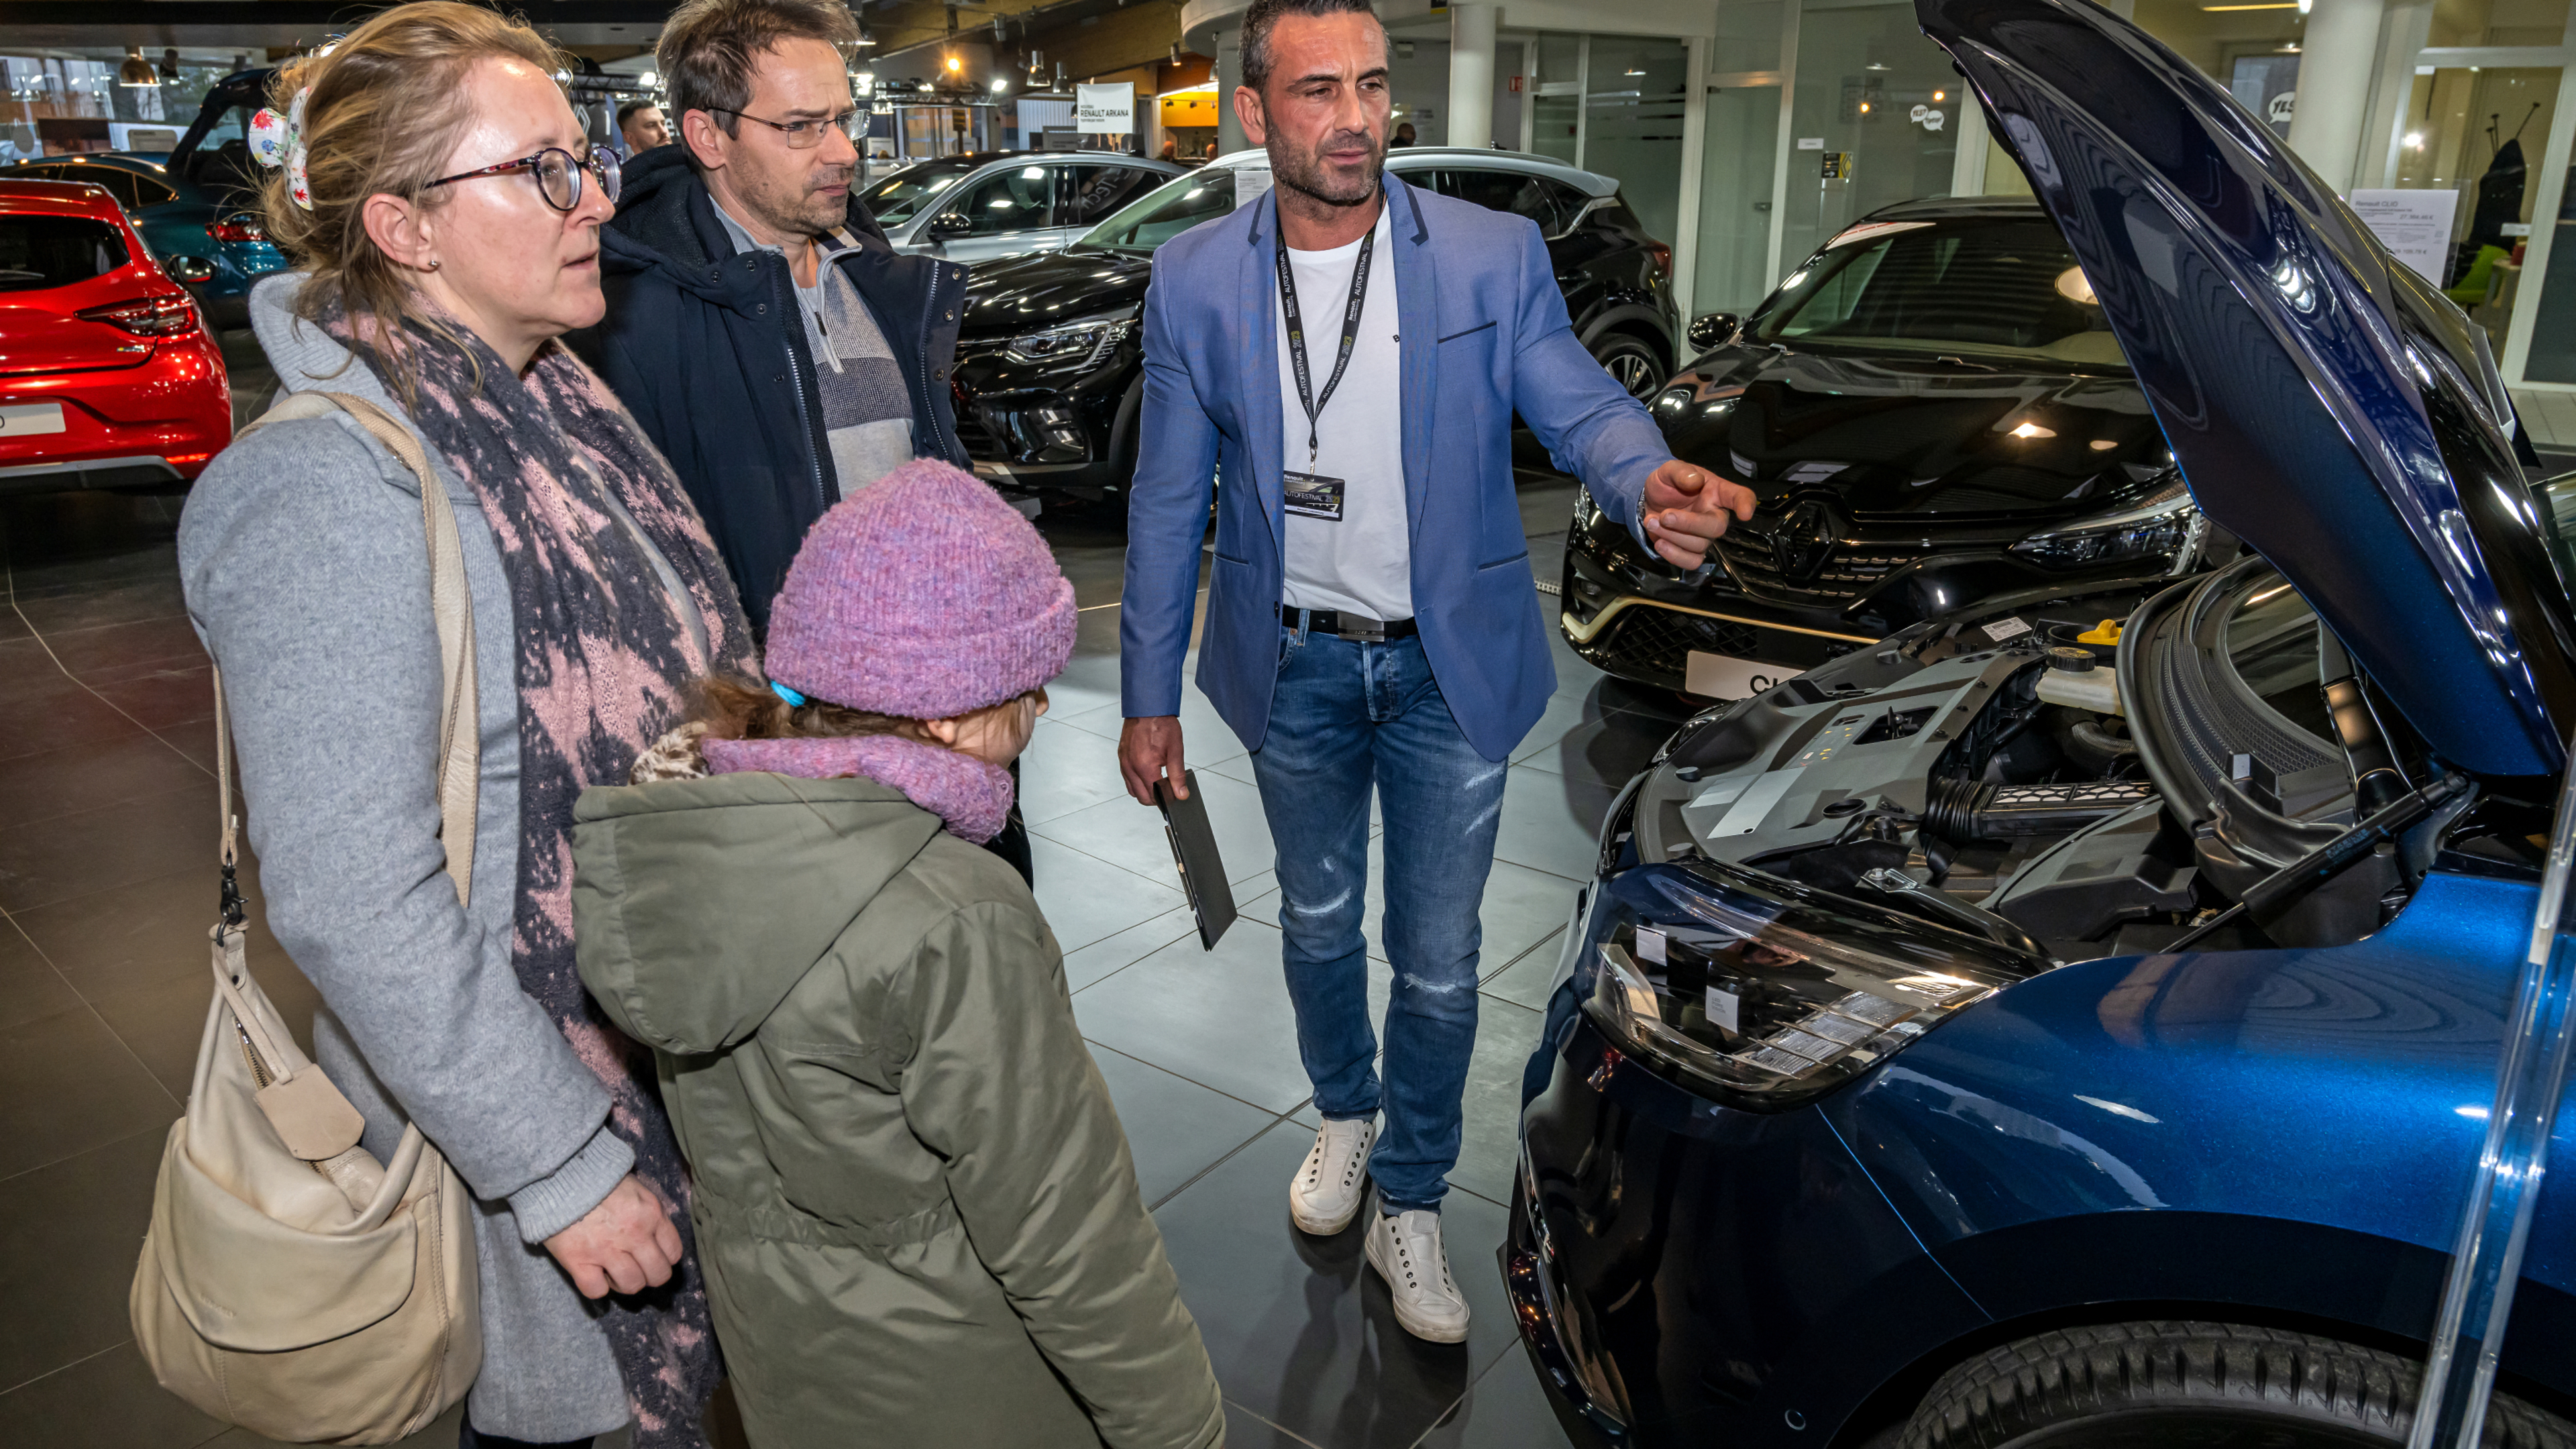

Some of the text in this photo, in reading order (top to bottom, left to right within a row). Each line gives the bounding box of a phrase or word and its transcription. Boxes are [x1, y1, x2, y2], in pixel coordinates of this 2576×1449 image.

[1354, 252, 1368, 296] AUTOFESTIVAL
[1295, 350, 1308, 396] AUTOFESTIVAL
[1322, 356, 1346, 399] AUTOFESTIVAL
[1284, 490, 1324, 502] AUTOFESTIVAL
